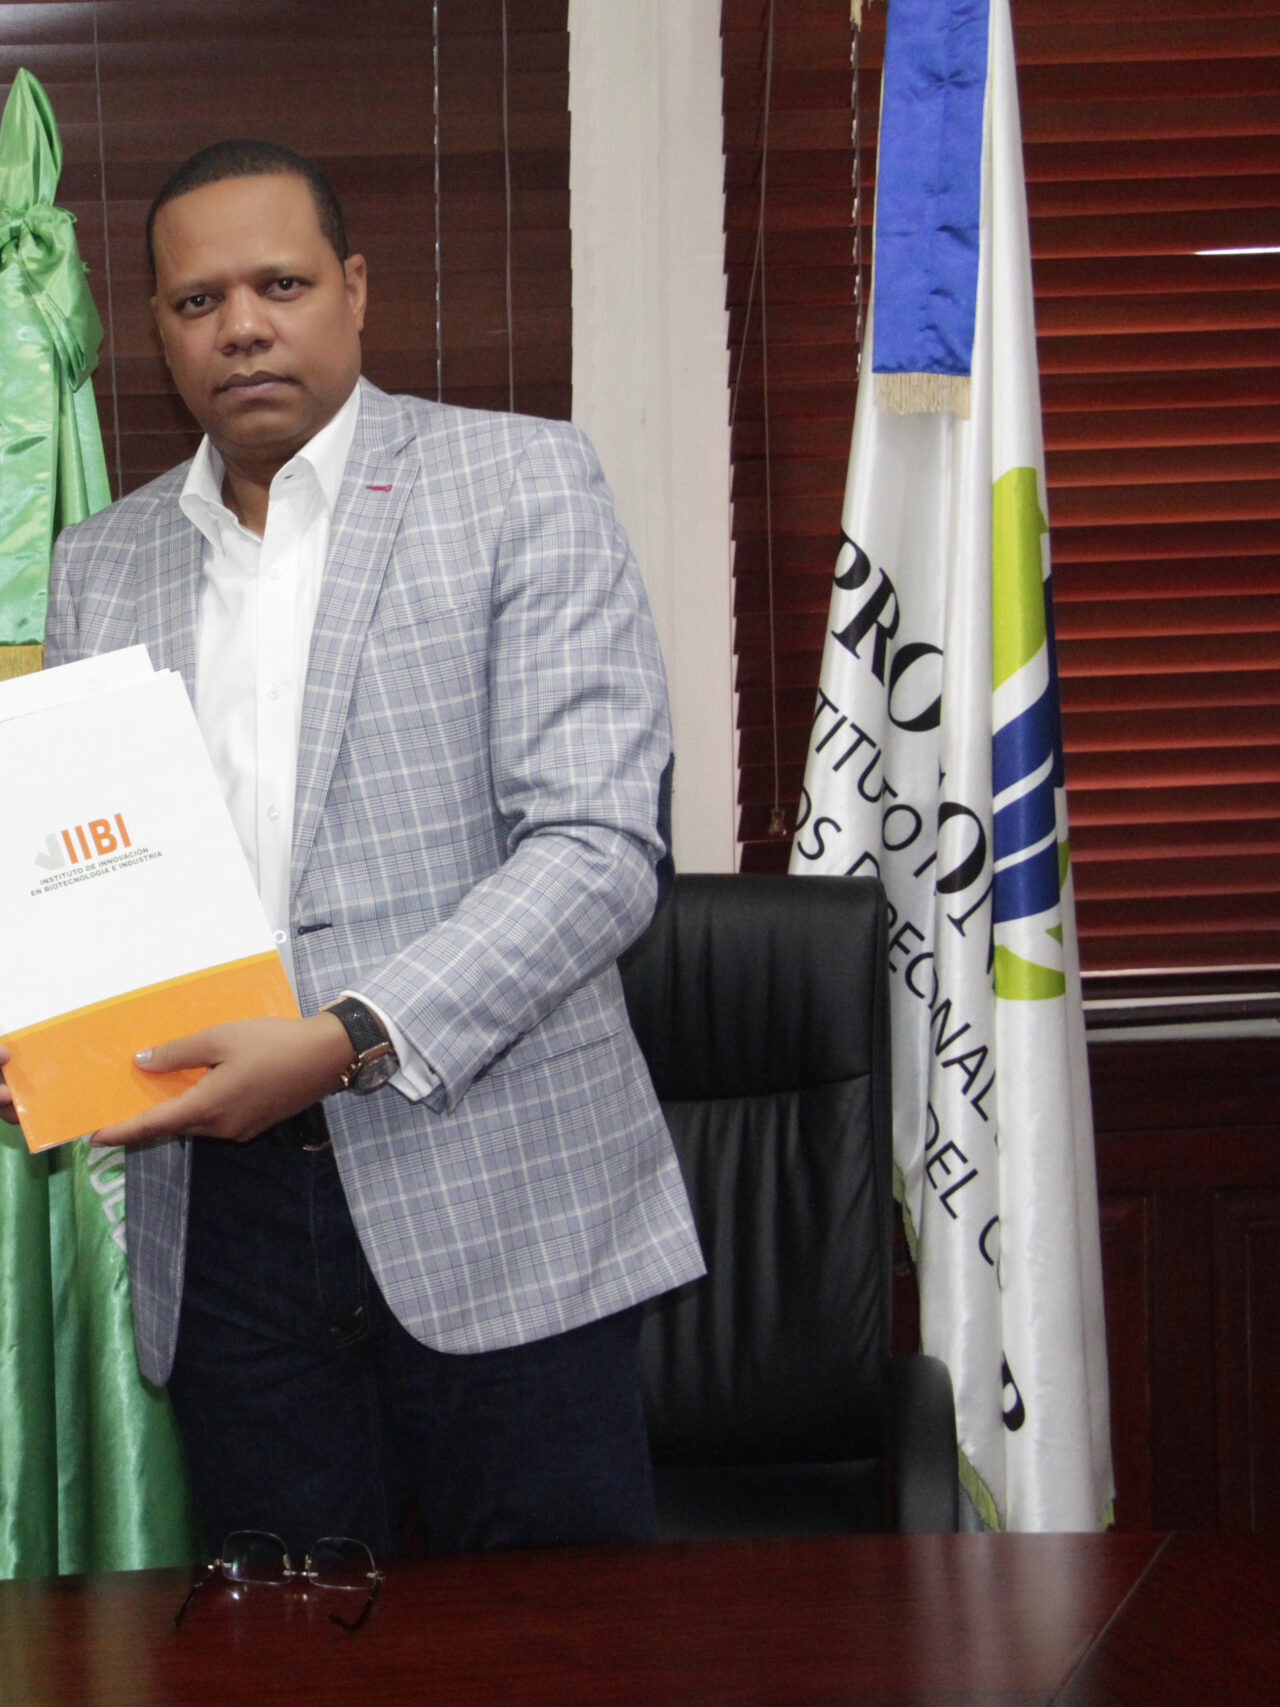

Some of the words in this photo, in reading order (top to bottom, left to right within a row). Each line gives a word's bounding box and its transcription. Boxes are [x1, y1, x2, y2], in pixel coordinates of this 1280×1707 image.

[61, 813, 132, 864] IIBI
[30, 888, 42, 897] EN
[119, 850, 163, 869] INDUSTRIA
[39, 867, 83, 885] INSTITUTO
[85, 863, 97, 872] DE
